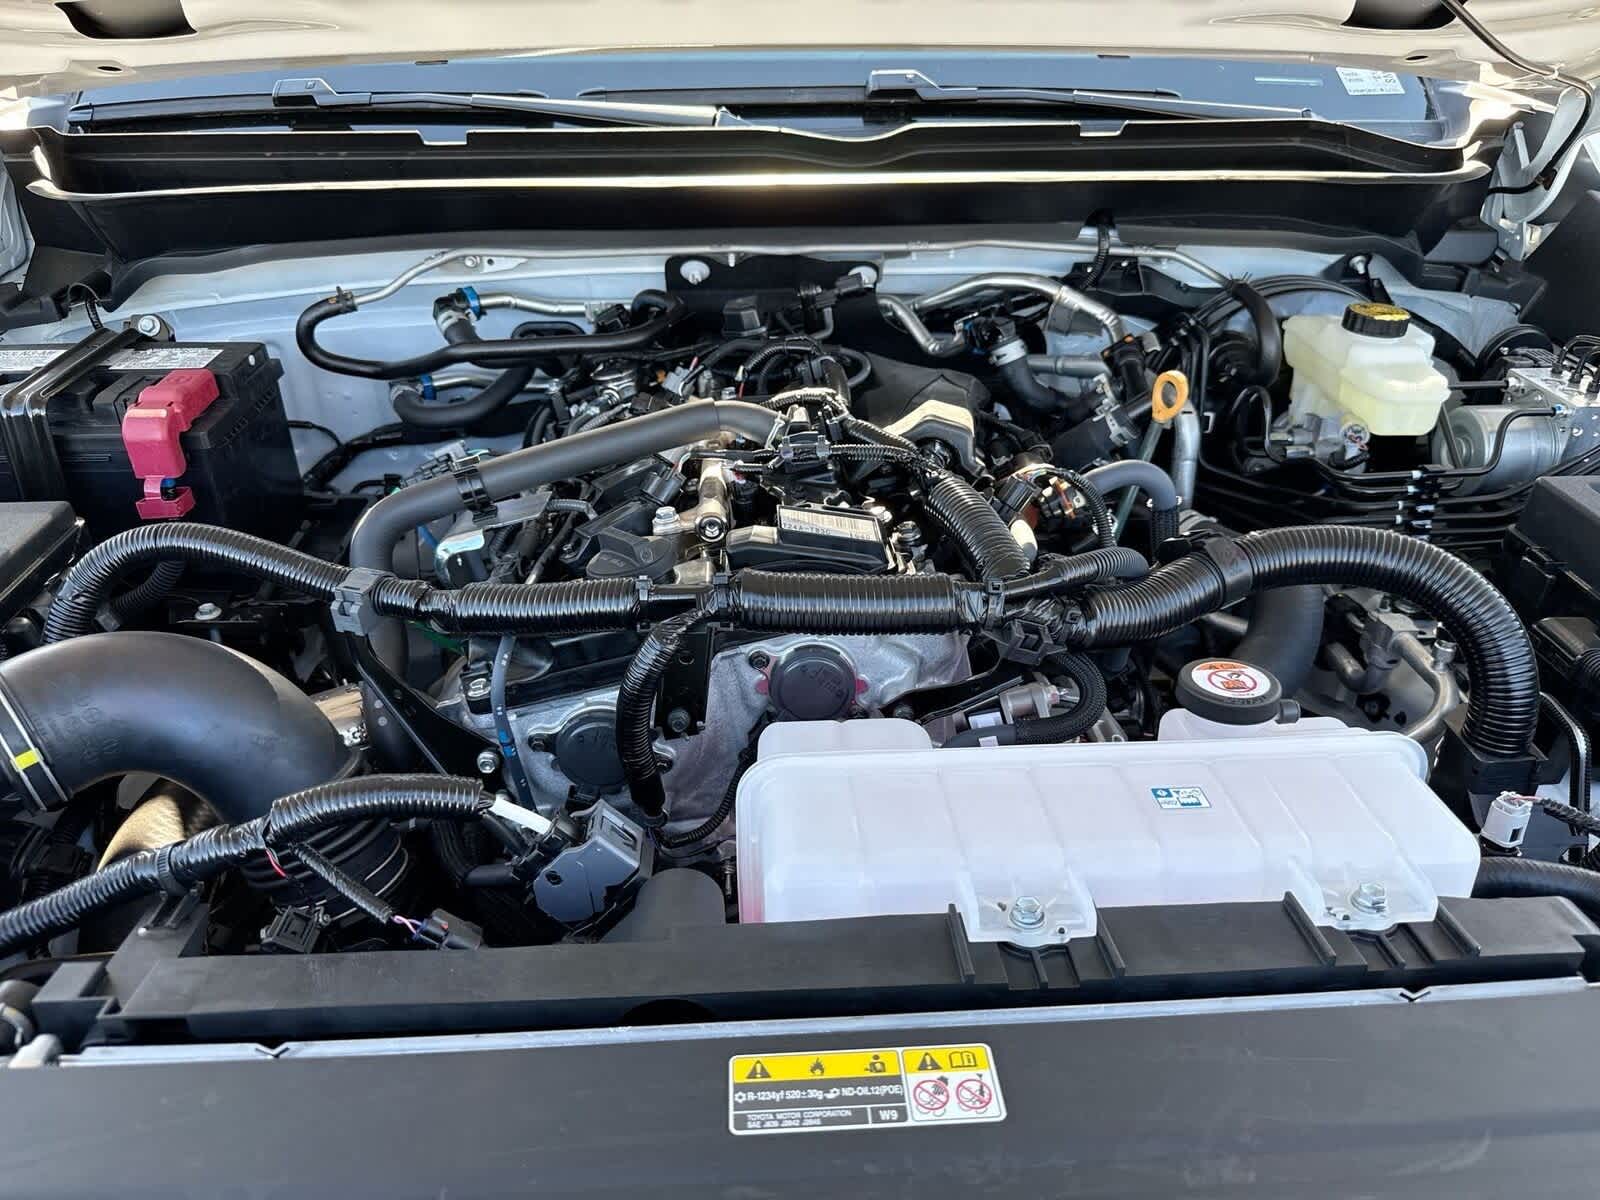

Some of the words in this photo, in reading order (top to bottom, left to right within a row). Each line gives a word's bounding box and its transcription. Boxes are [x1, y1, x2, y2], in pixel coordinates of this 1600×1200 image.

[747, 1089, 784, 1102] R-1234yf
[785, 1088, 824, 1100] 520±30g
[747, 1113, 774, 1121] TOYOTA
[802, 1109, 852, 1118] CORPORATION
[880, 1110, 898, 1120] W9
